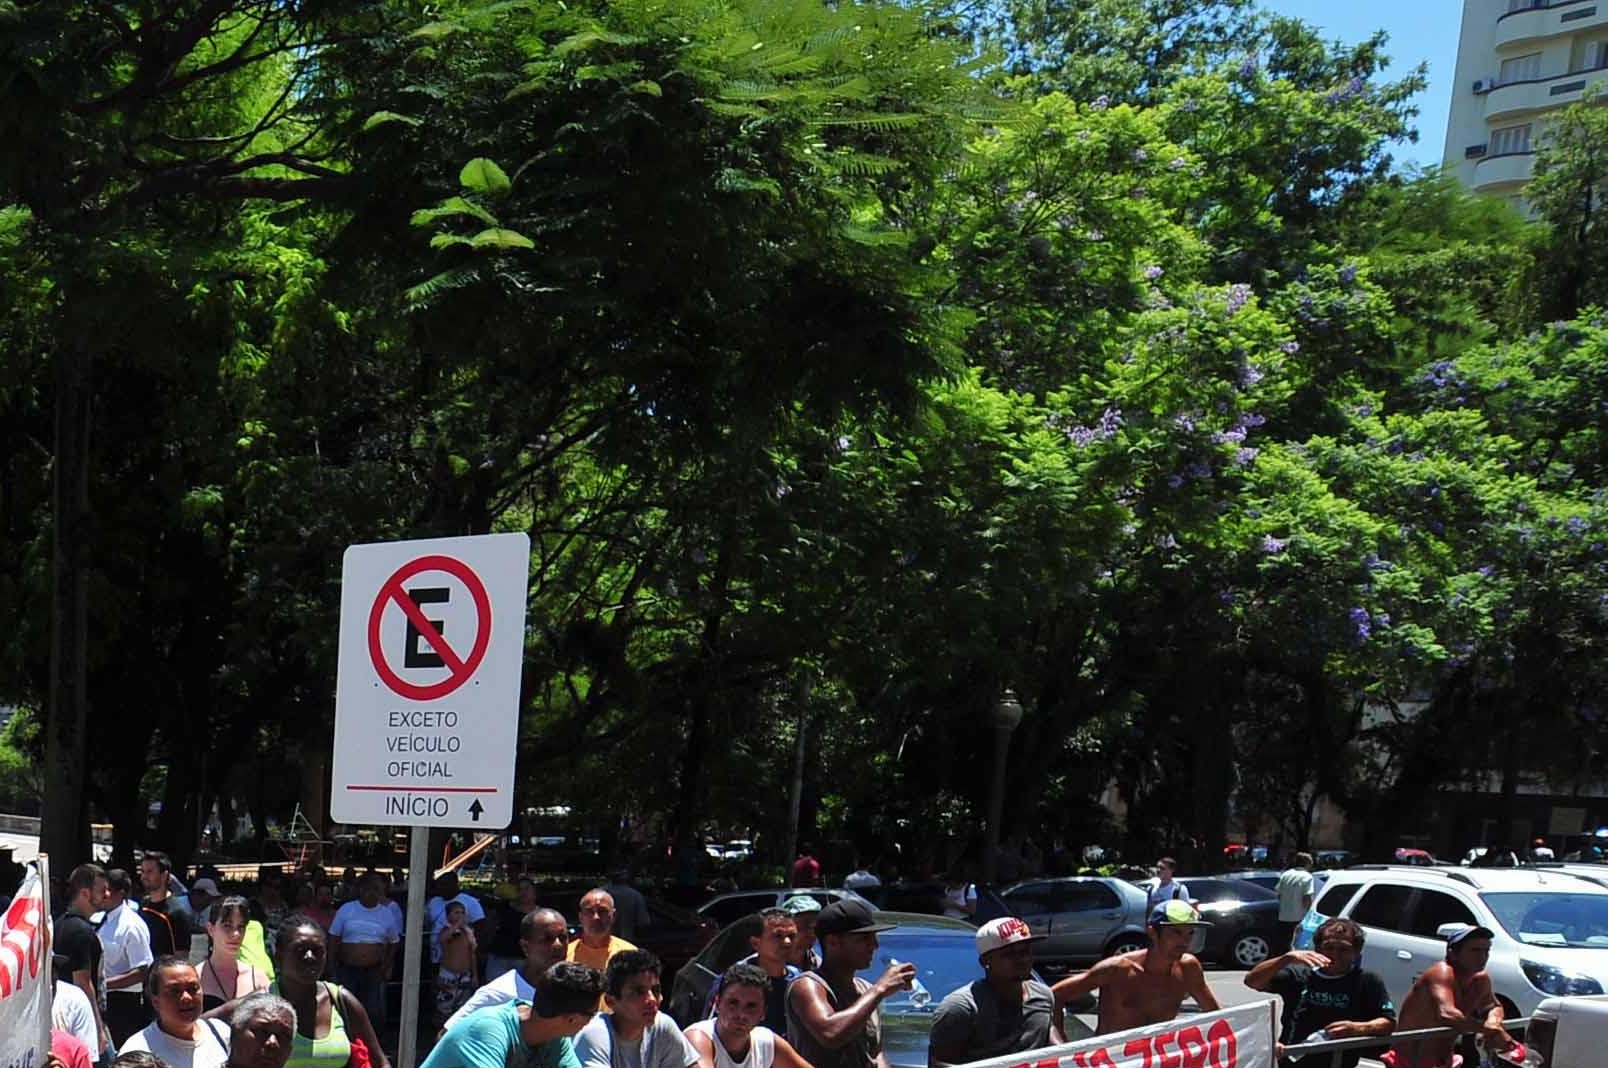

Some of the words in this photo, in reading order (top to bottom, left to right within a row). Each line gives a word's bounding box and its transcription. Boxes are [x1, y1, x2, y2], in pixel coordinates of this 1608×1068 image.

[388, 711, 458, 728] EXCETO
[386, 732, 461, 753] VEÍCULO
[387, 761, 453, 778] OFICIAL
[385, 793, 449, 817] INÍCIO
